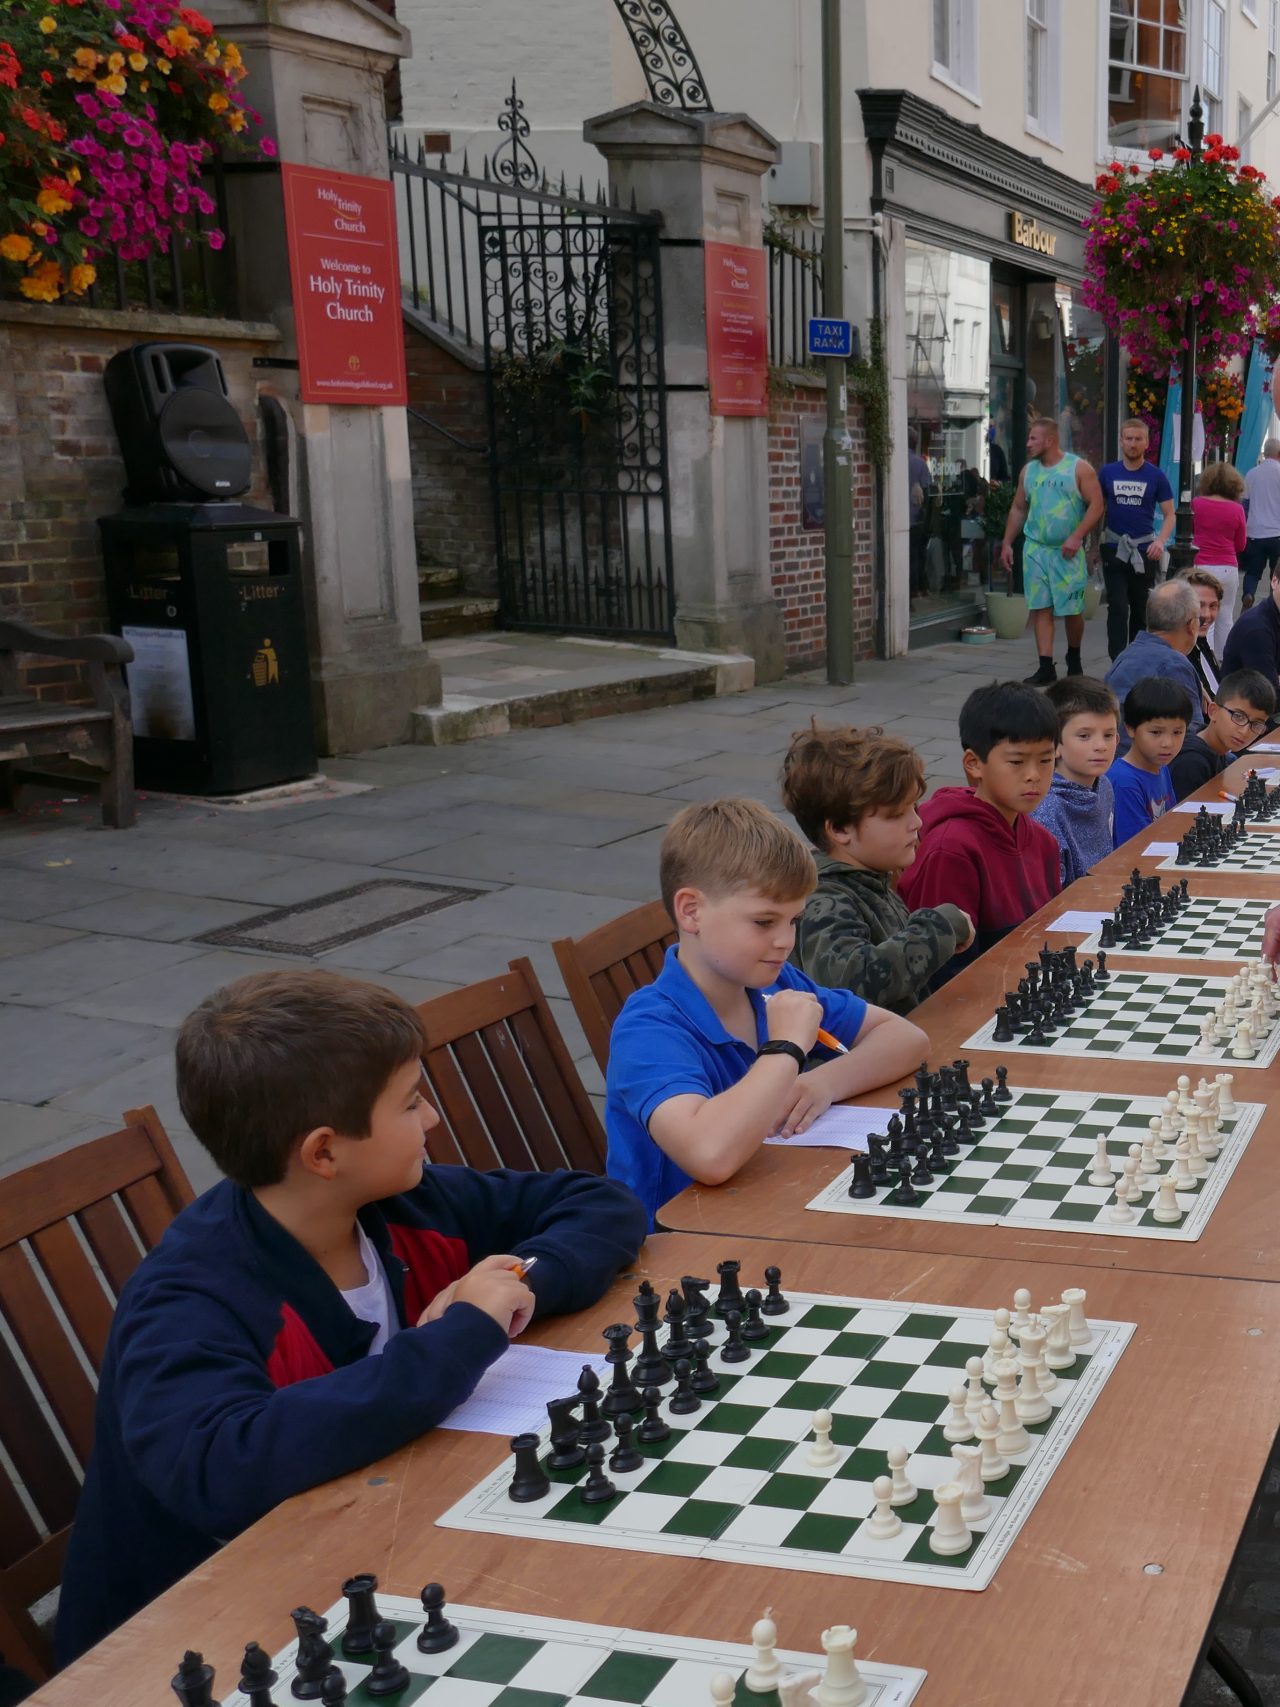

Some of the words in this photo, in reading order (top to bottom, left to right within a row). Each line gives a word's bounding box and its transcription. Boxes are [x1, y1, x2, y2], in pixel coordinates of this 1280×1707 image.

[318, 188, 338, 204] Holy
[336, 198, 362, 215] Trinity
[334, 218, 366, 233] Church
[1012, 211, 1057, 256] Barbour
[320, 258, 361, 273] Welcome
[363, 265, 372, 275] to
[310, 275, 342, 299] Holy
[345, 279, 385, 304] Trinity
[326, 302, 374, 322] Church
[817, 324, 843, 336] TAXI
[814, 337, 845, 349] RANK
[1116, 496, 1142, 506] ORLANDO
